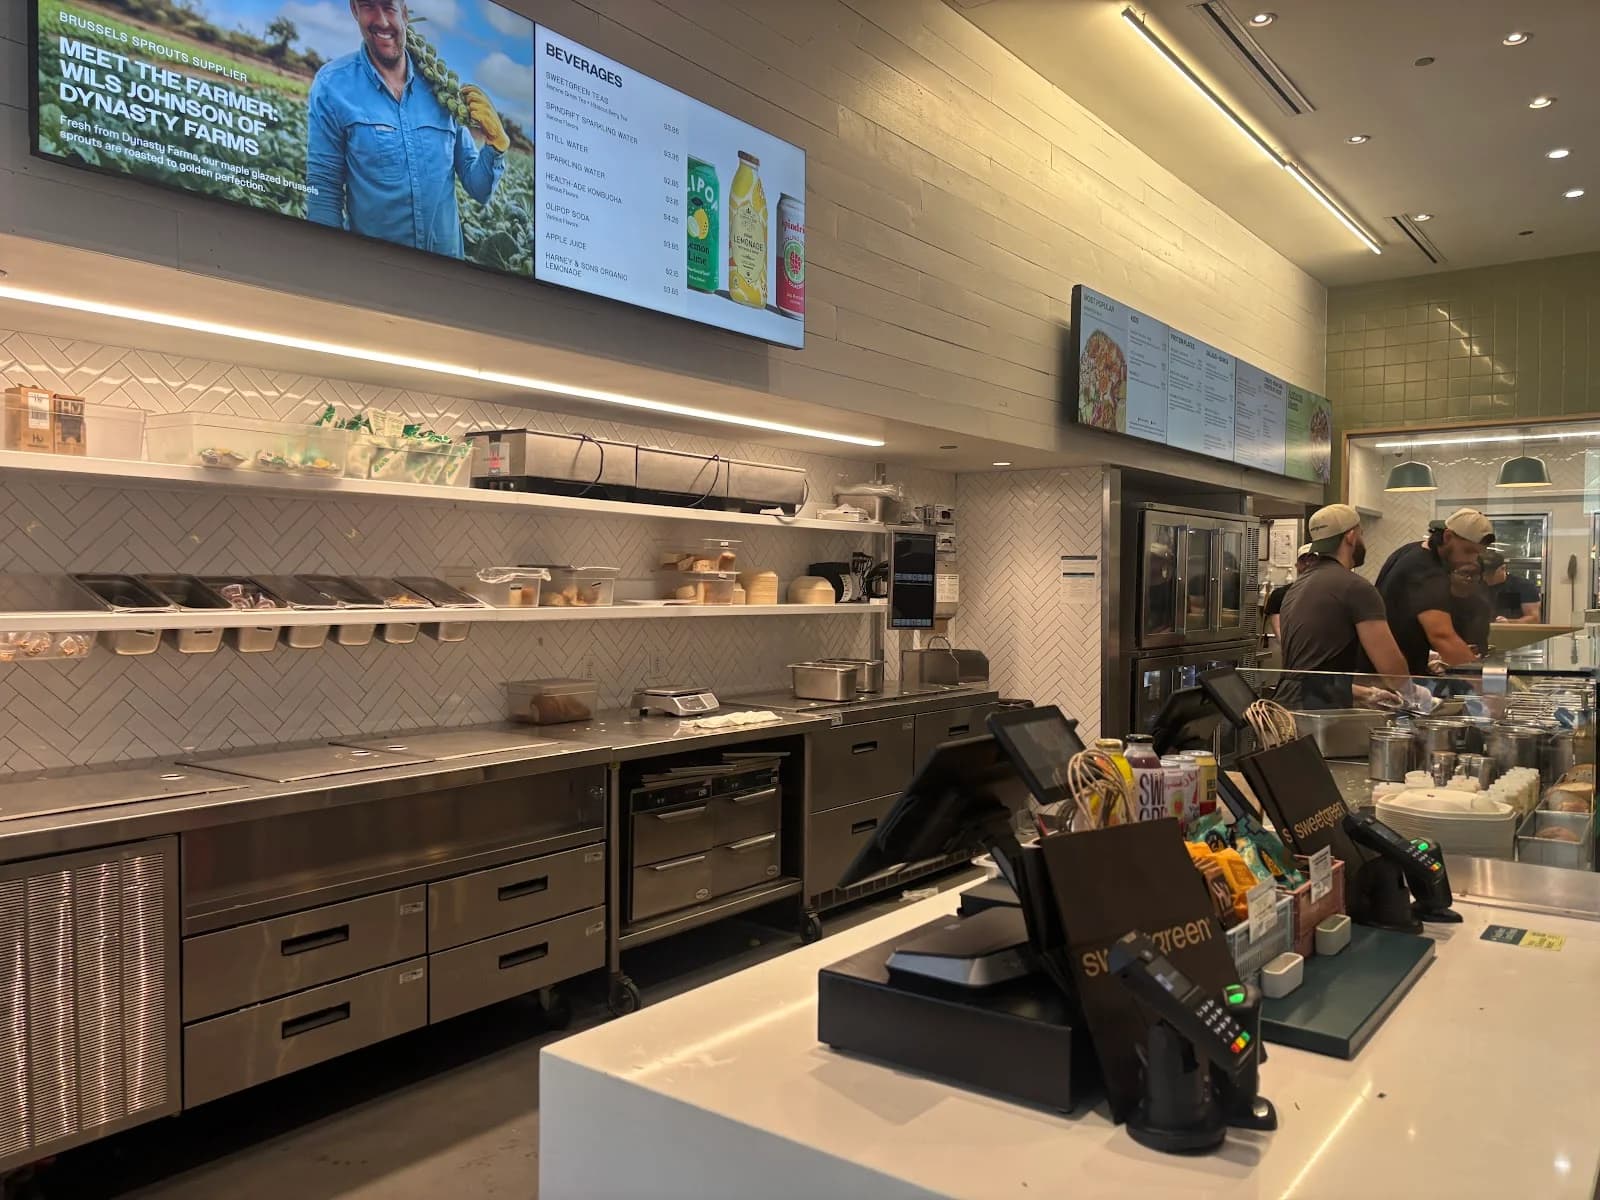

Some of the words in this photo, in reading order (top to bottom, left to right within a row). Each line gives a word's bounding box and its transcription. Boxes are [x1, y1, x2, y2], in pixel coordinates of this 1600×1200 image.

[60, 11, 128, 43] BRUSSELS
[132, 35, 189, 63] SPROUTS
[192, 56, 248, 83] SUPPLIER
[546, 42, 623, 88] BEVERAGES
[60, 36, 129, 73] MEET
[135, 60, 182, 91] THE
[186, 77, 278, 122] FARMER:
[60, 59, 122, 94] WILS
[127, 81, 233, 128] JOHNSON
[238, 116, 267, 136] OF
[545, 71, 591, 96] SWEETGREEN
[592, 91, 609, 105] TEAS
[60, 82, 180, 131] DYNASTY
[184, 119, 259, 156] FARMS
[545, 102, 580, 120] SPINDRIFT
[581, 116, 616, 136] SPARKLING
[618, 131, 638, 144] WATER
[60, 114, 91, 132] Fresh
[94, 124, 120, 140] from
[122, 132, 165, 154] Dynasty
[168, 144, 201, 162] Farms,
[203, 155, 219, 167] our
[221, 162, 249, 176] maple
[251, 169, 281, 185] glazed
[283, 176, 319, 196] brussels
[60, 130, 103, 149] sprouts
[105, 141, 122, 153] are
[124, 147, 164, 164] roasted
[166, 158, 178, 168] to
[180, 162, 213, 178] golden
[215, 172, 266, 192] perfection.
[545, 132, 564, 145] STILL
[566, 139, 588, 153] WATER
[545, 152, 582, 171] SPARKLING
[584, 167, 605, 179] WATER
[545, 172, 586, 192] HEALTH-ADE
[587, 188, 622, 204] KOMBUCHA
[545, 202, 570, 215] OLIPOP
[571, 210, 590, 222] SODA
[545, 232, 568, 245] APPLE
[569, 240, 587, 250] JUICE
[733, 234, 763, 252] LEMONADE
[545, 252, 573, 266] HARNEY
[581, 262, 599, 273] SONS
[600, 267, 628, 281] ORGANIC
[545, 261, 582, 277] LEMONADE
[1294, 802, 1346, 839] sweetgreen
[1082, 917, 1213, 977] swgreen
